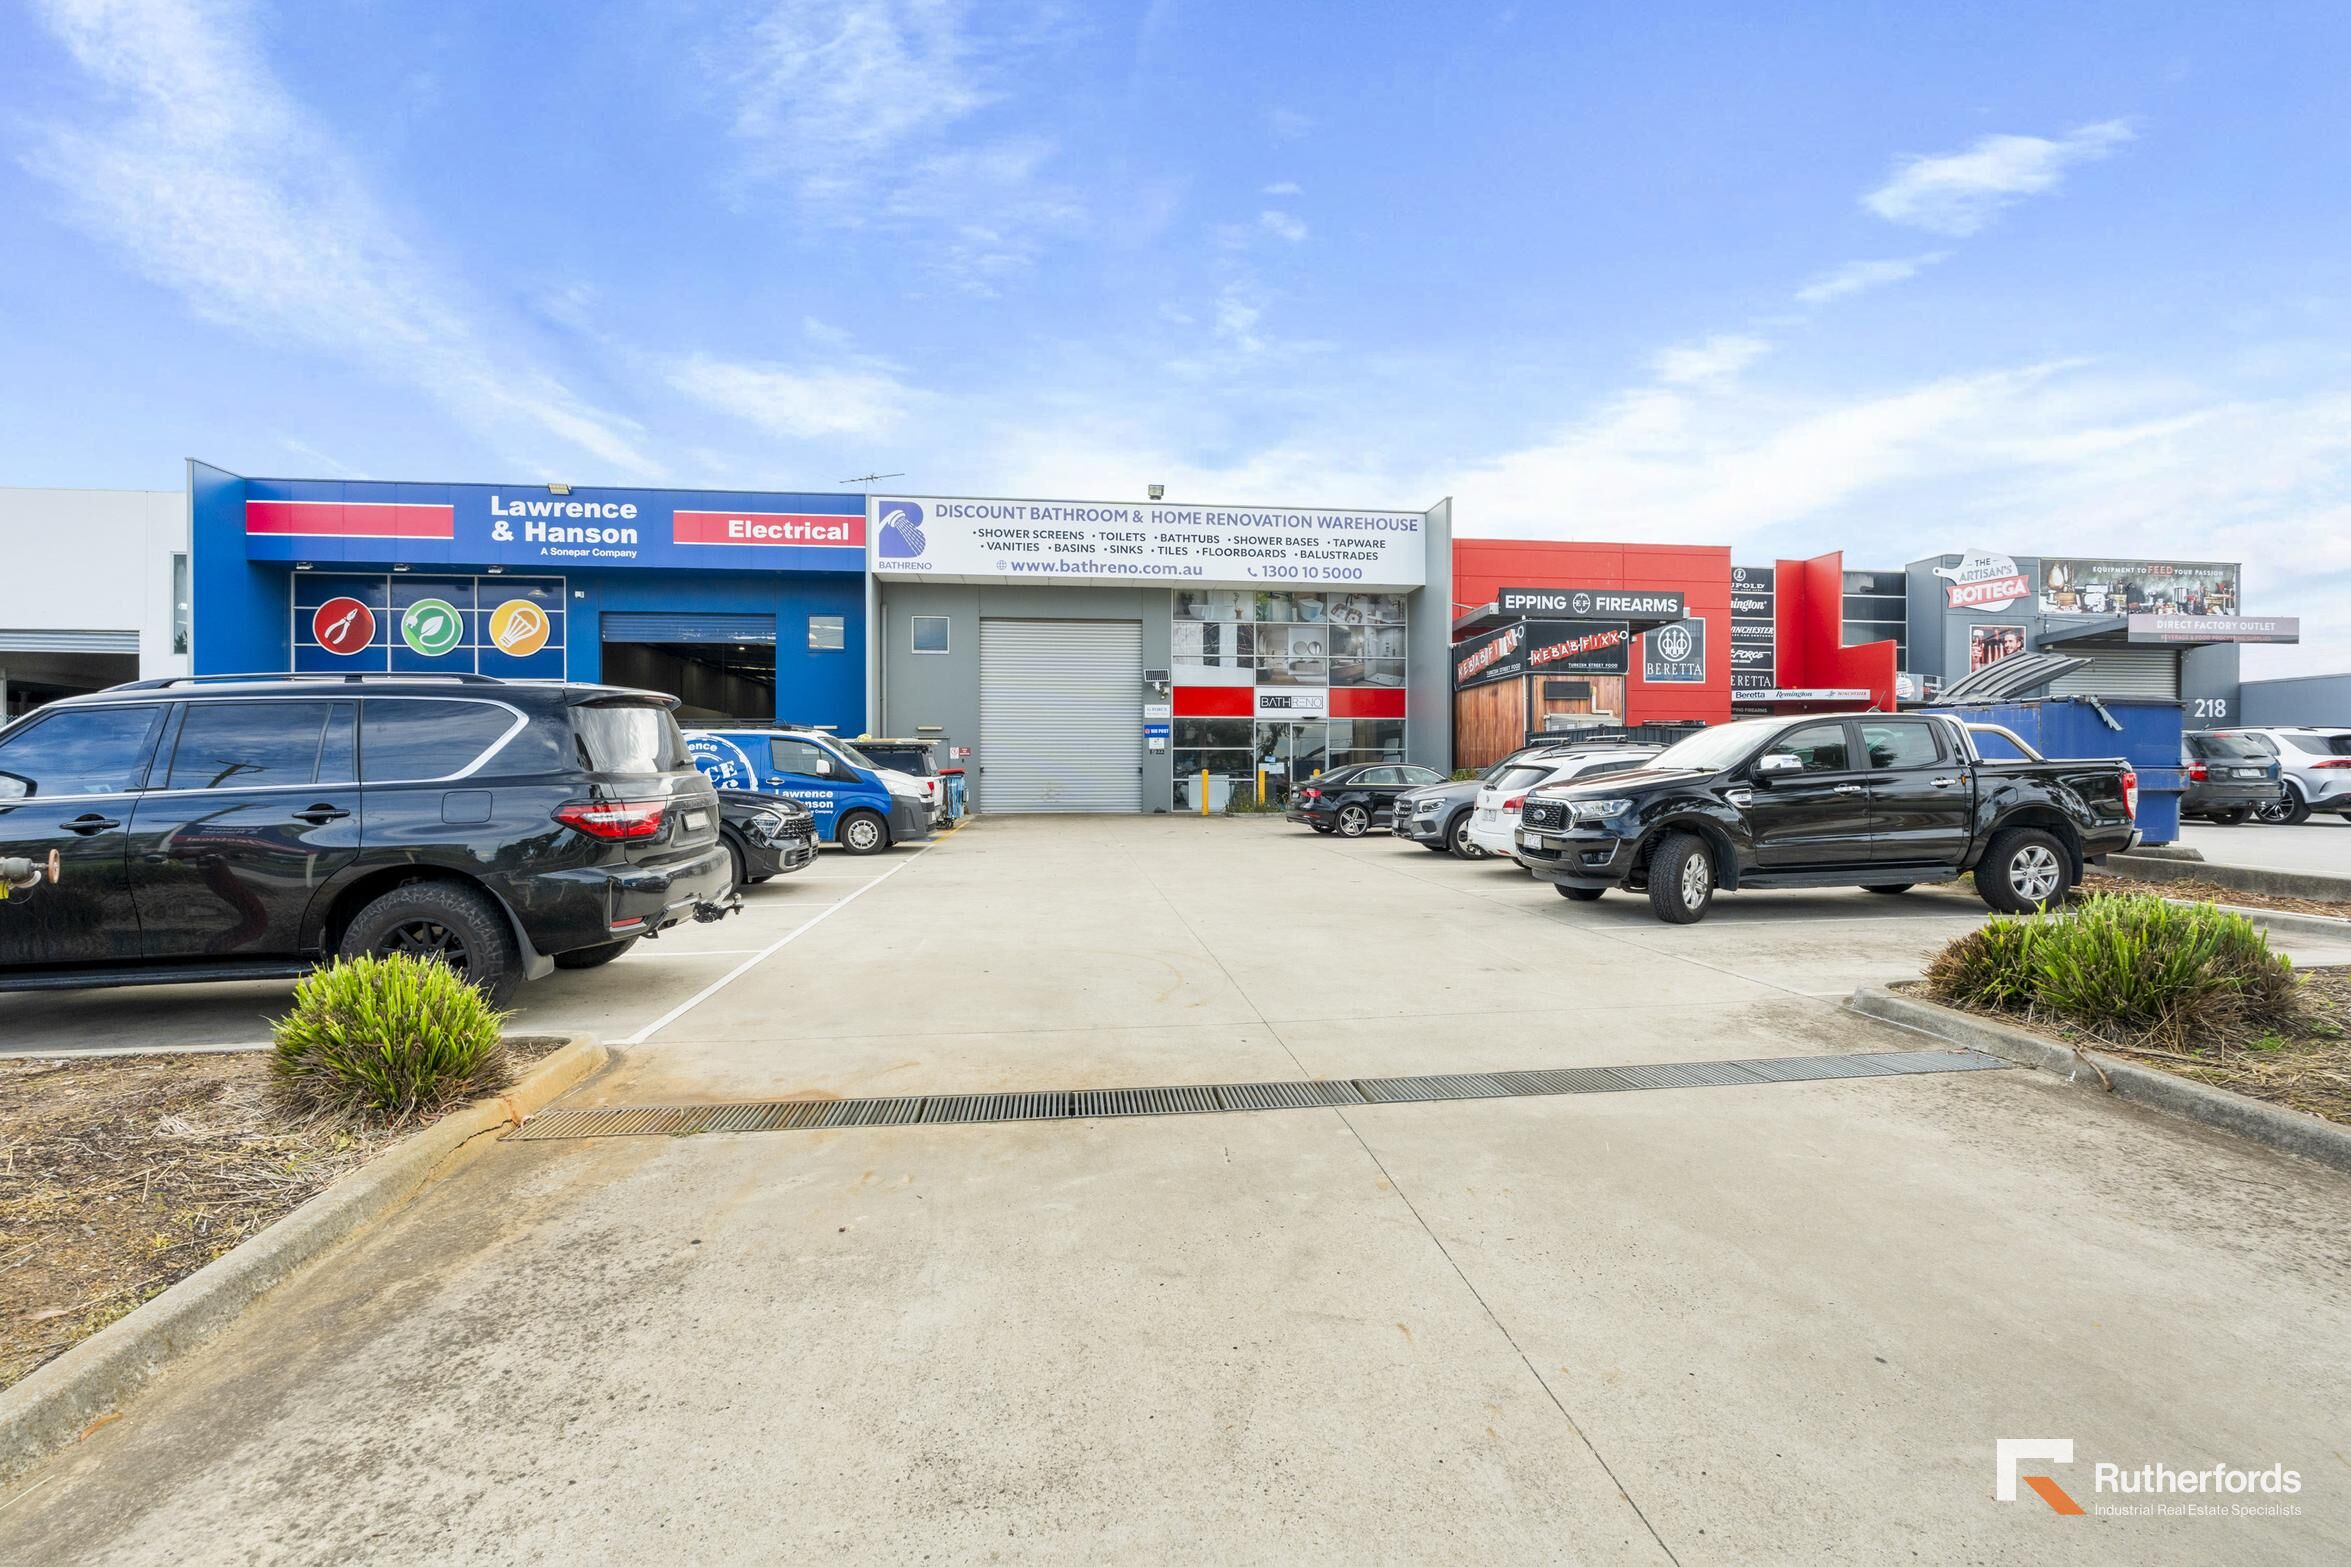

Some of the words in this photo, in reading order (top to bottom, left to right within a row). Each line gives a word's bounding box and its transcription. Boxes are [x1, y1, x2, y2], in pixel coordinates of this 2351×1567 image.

[491, 495, 638, 519] Lawrence
[936, 504, 1028, 520] DISCOUNT
[1030, 506, 1128, 523] BATHROOM
[1132, 509, 1144, 523] &
[1151, 510, 1202, 526] HOME
[1206, 512, 1313, 529] RENOVATION
[1316, 515, 1418, 532] WAREHOUSE
[491, 520, 514, 542] &
[525, 521, 638, 544] Hanson
[728, 519, 849, 541] Electrical
[978, 528, 1030, 539] SHOWER
[1033, 530, 1085, 541] SCREENS
[1099, 532, 1147, 542] TOILETS
[1160, 533, 1220, 544] BATHTUBS
[1234, 535, 1283, 546] SHOWER
[1285, 537, 1320, 547] BASES
[1333, 538, 1386, 549] TAPWARE
[540, 547, 548, 555] A
[550, 547, 590, 558] Sonepar
[592, 548, 637, 559] Company
[987, 541, 1040, 552] VANITIES
[1054, 543, 1096, 553] BASINS
[1109, 545, 1144, 555] SINKS
[1158, 546, 1188, 556] TILES
[1202, 547, 1287, 559] FLOORBOARDS
[1300, 550, 1379, 561] BALUSTRADES
[879, 561, 932, 570] BATHRENO
[1011, 558, 1203, 576] www.bathreno.com.au
[1262, 565, 1299, 578] 1300
[1303, 566, 1318, 578] 10
[1322, 567, 1363, 580] 5000
[1975, 558, 1991, 567] THE
[2092, 566, 2134, 574] EQUIPMENT
[2148, 565, 2173, 575] FEED
[2174, 568, 2193, 576] YOUR
[2195, 569, 2224, 577] PASSION
[1959, 565, 2012, 583] ARTISAN'S
[1953, 579, 2027, 604] BOTTEGA
[1505, 594, 1567, 610] EPPING
[1596, 597, 1678, 613] FIREARMS
[2157, 619, 2192, 630] DIRECT
[2194, 620, 2238, 631] FACTORY
[2240, 621, 2276, 631] OUTLET
[1533, 641, 1579, 663] KEBAB
[1583, 634, 1619, 649] FIXX
[1458, 654, 1486, 676] KEBAB
[1647, 663, 1703, 676] BERETTA
[1731, 675, 1771, 687] ERETTA
[1261, 697, 1323, 708] BATHRENO
[1735, 691, 1765, 699] Beretta
[1776, 690, 1813, 699] Remington
[2194, 699, 2227, 718] 218
